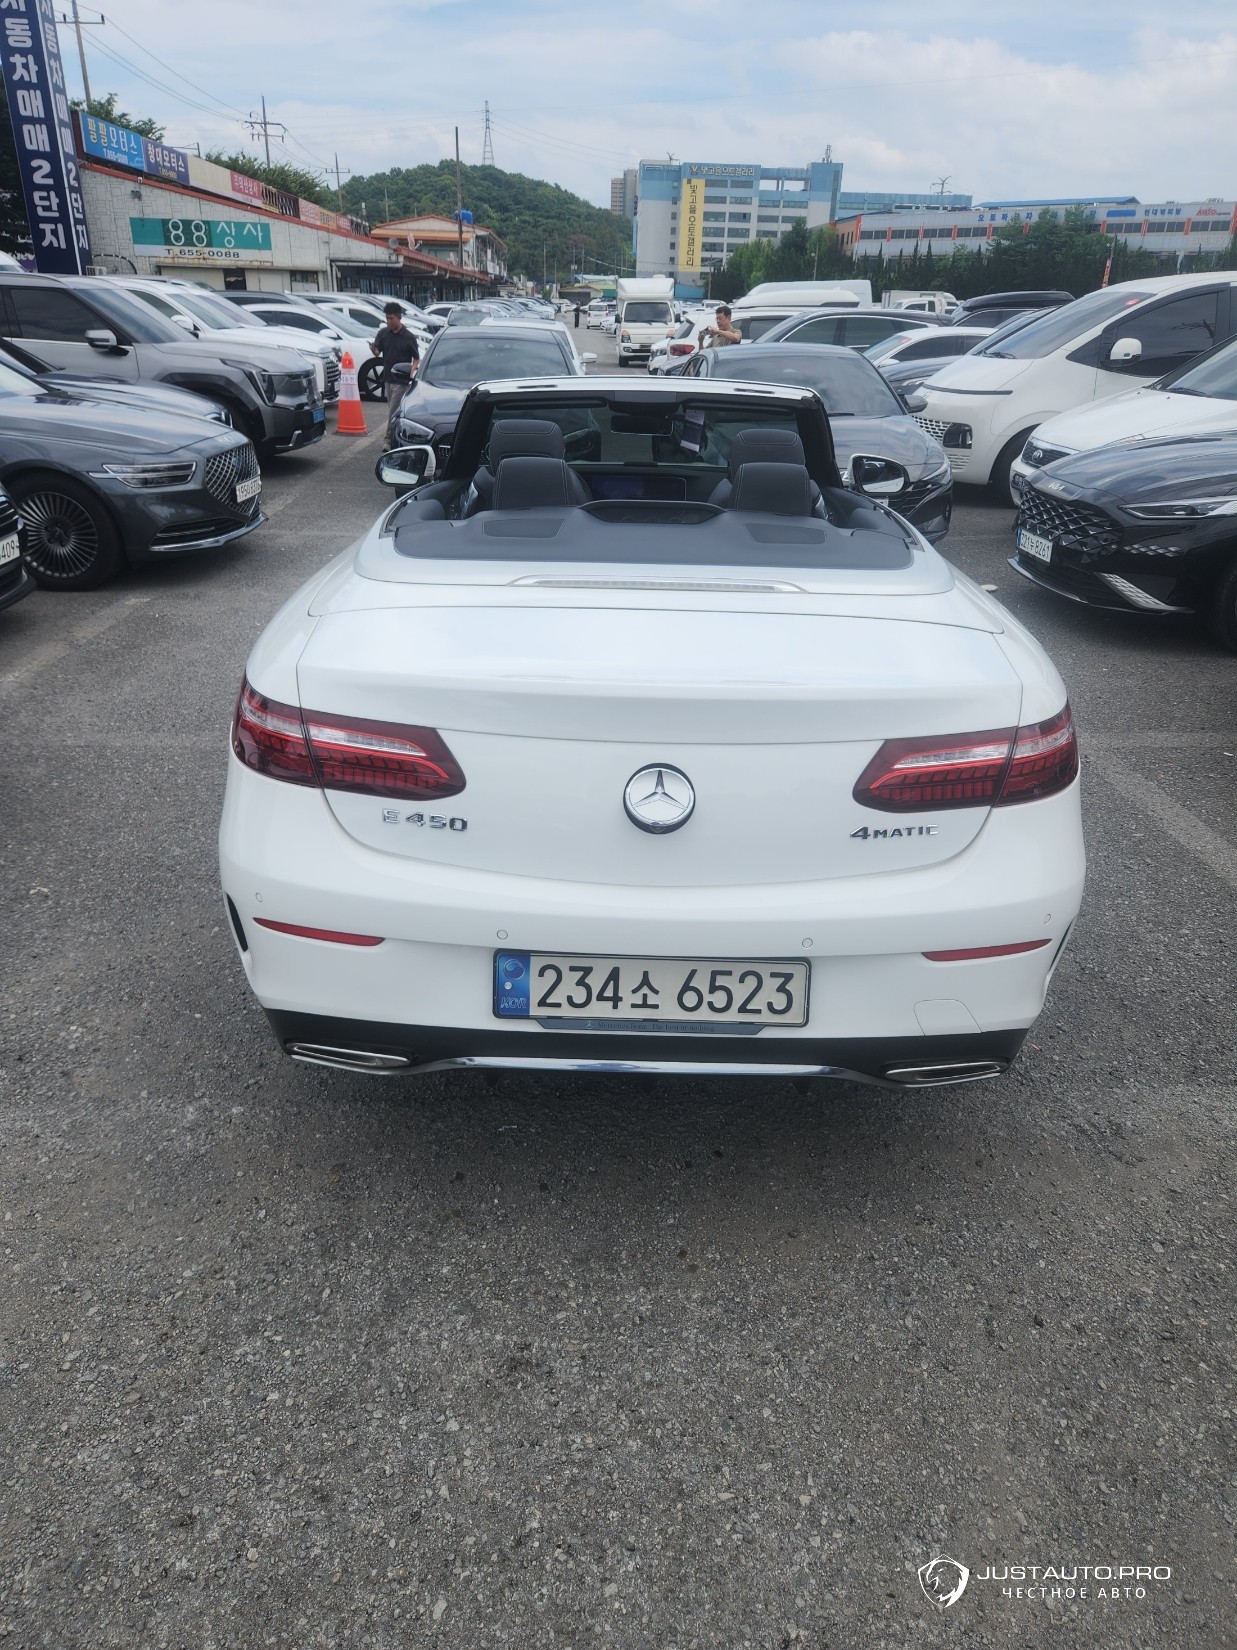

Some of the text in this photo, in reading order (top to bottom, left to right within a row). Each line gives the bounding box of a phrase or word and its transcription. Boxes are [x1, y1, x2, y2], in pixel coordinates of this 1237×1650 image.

[88, 117, 138, 155] 팔팔모터스
[686, 184, 698, 267] 빛고을오토갤러리
[164, 248, 240, 258] T.655-0088
[0, 540, 14, 559] 409
[382, 808, 468, 832] E 450
[850, 824, 939, 840] 4MATIC
[537, 963, 795, 1015] 234소 6523
[500, 996, 527, 1009] KOR
